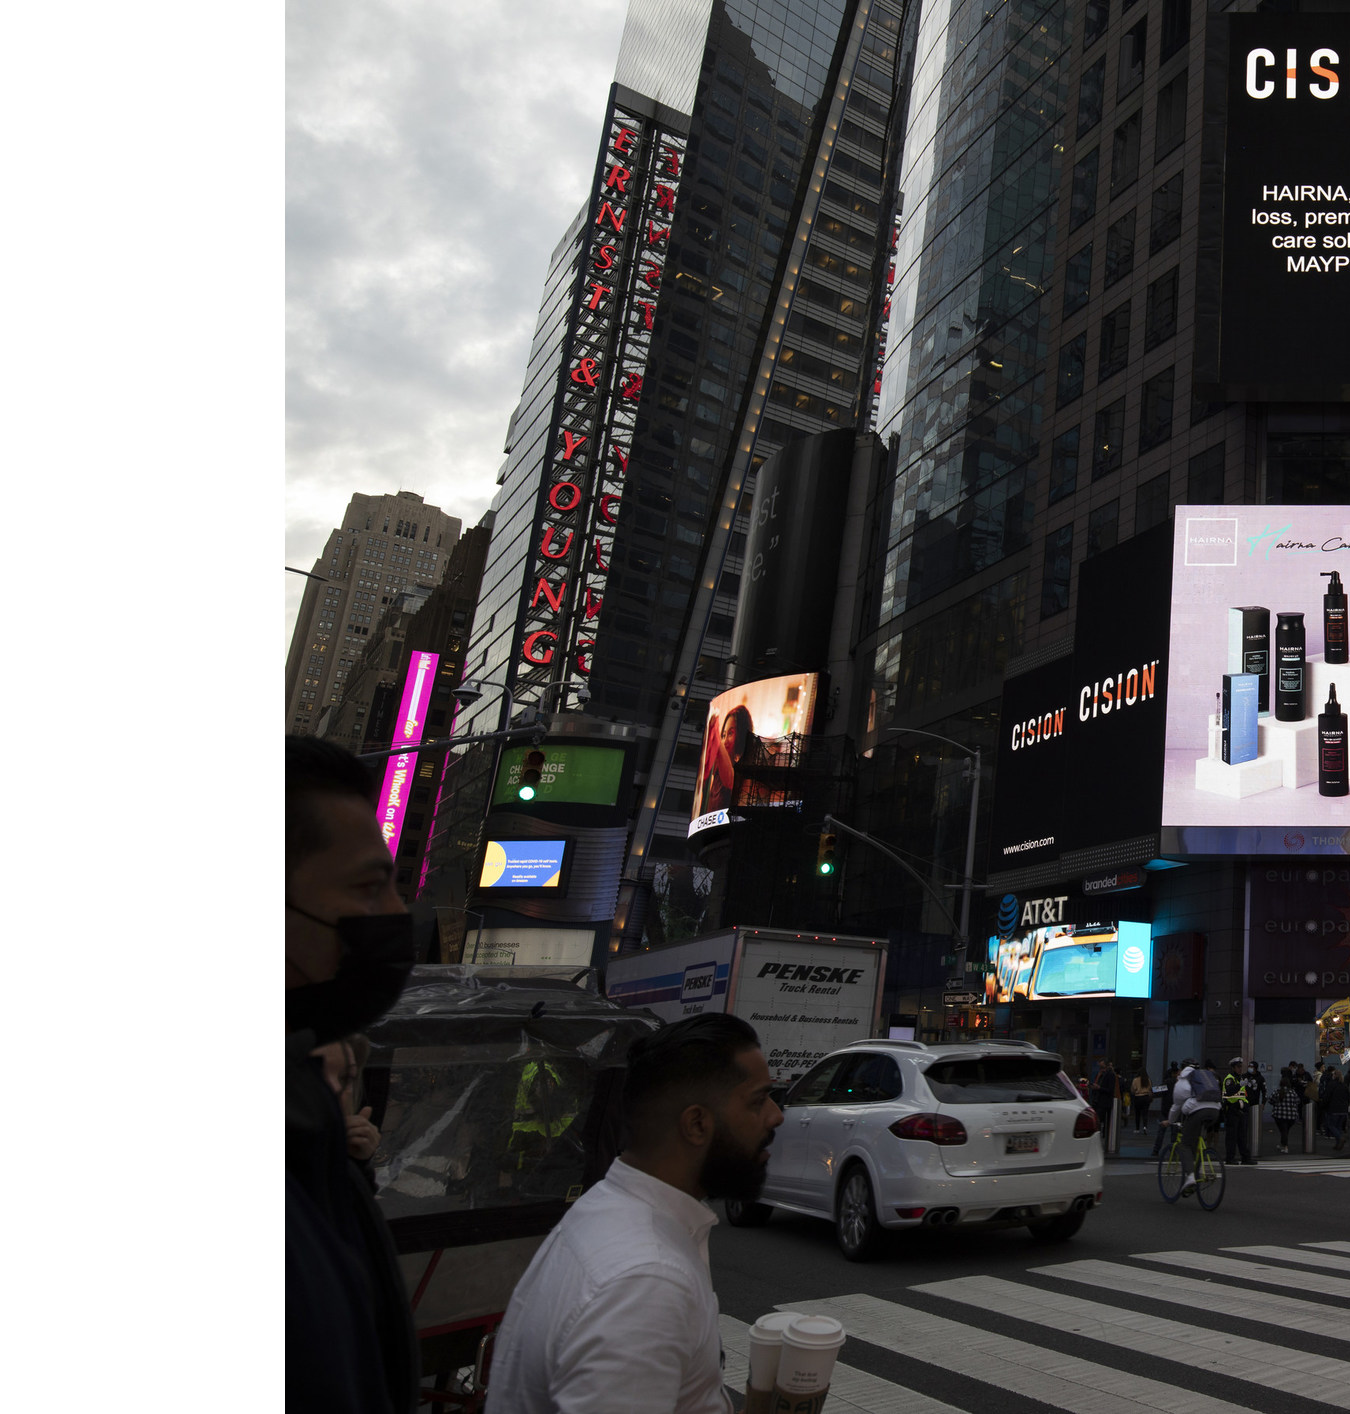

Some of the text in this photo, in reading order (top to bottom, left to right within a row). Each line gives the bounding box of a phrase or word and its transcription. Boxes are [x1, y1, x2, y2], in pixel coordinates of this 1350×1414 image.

[1251, 209, 1298, 227] loss,
[1271, 236, 1316, 249] care
[523, 128, 636, 664] ERNST & YOUNG
[1079, 661, 1156, 722] CISION
[1011, 707, 1065, 751] CISION
[698, 815, 717, 829] CHASE
[1003, 835, 1055, 855] www.cision.com
[1021, 896, 1069, 927] AT&T
[684, 974, 714, 991] PENSKE
[757, 962, 864, 984] PENSKE
[779, 983, 842, 995] Truck Rental
[750, 1013, 789, 1023] Household
[798, 1014, 832, 1024] Business
[832, 1016, 858, 1025] Rentals
